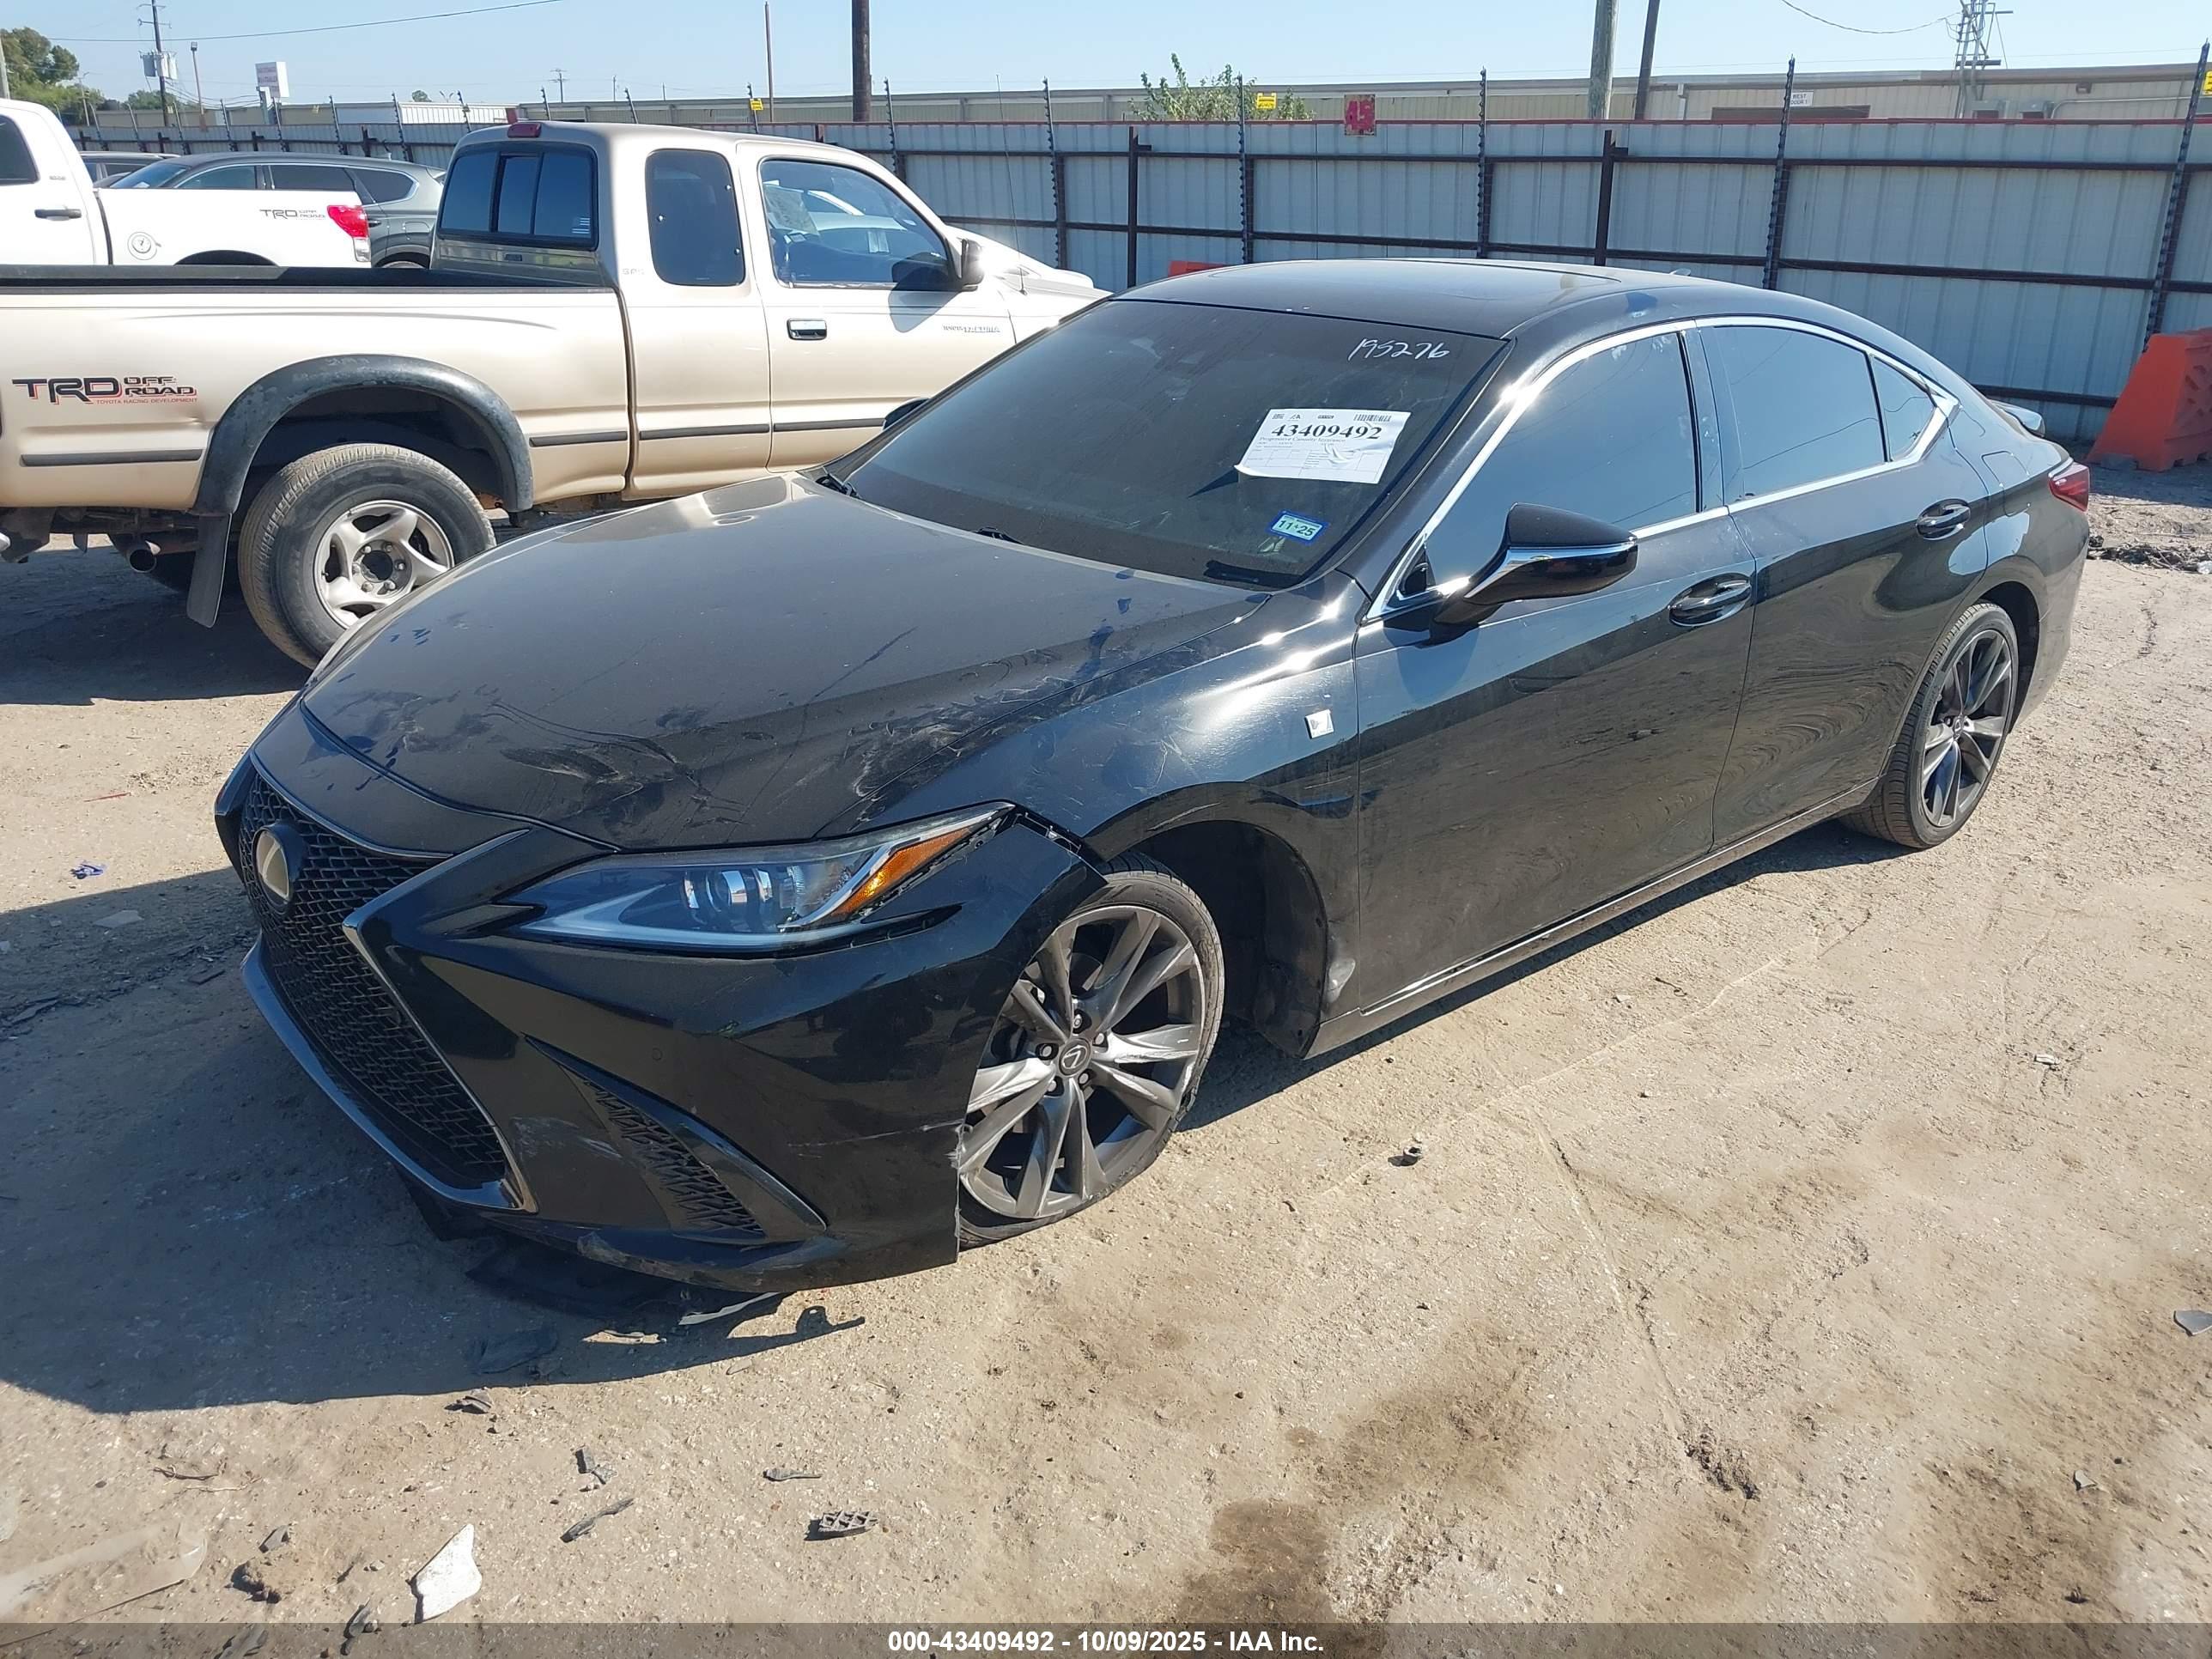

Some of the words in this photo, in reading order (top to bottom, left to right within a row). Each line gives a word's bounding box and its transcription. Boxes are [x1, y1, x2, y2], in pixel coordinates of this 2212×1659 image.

[259, 209, 298, 220] TRD
[1347, 338, 1451, 362] 195276
[124, 375, 175, 386] OFF
[11, 376, 123, 404] TRD
[125, 386, 198, 397] ROAD
[1272, 424, 1382, 440] 43409492
